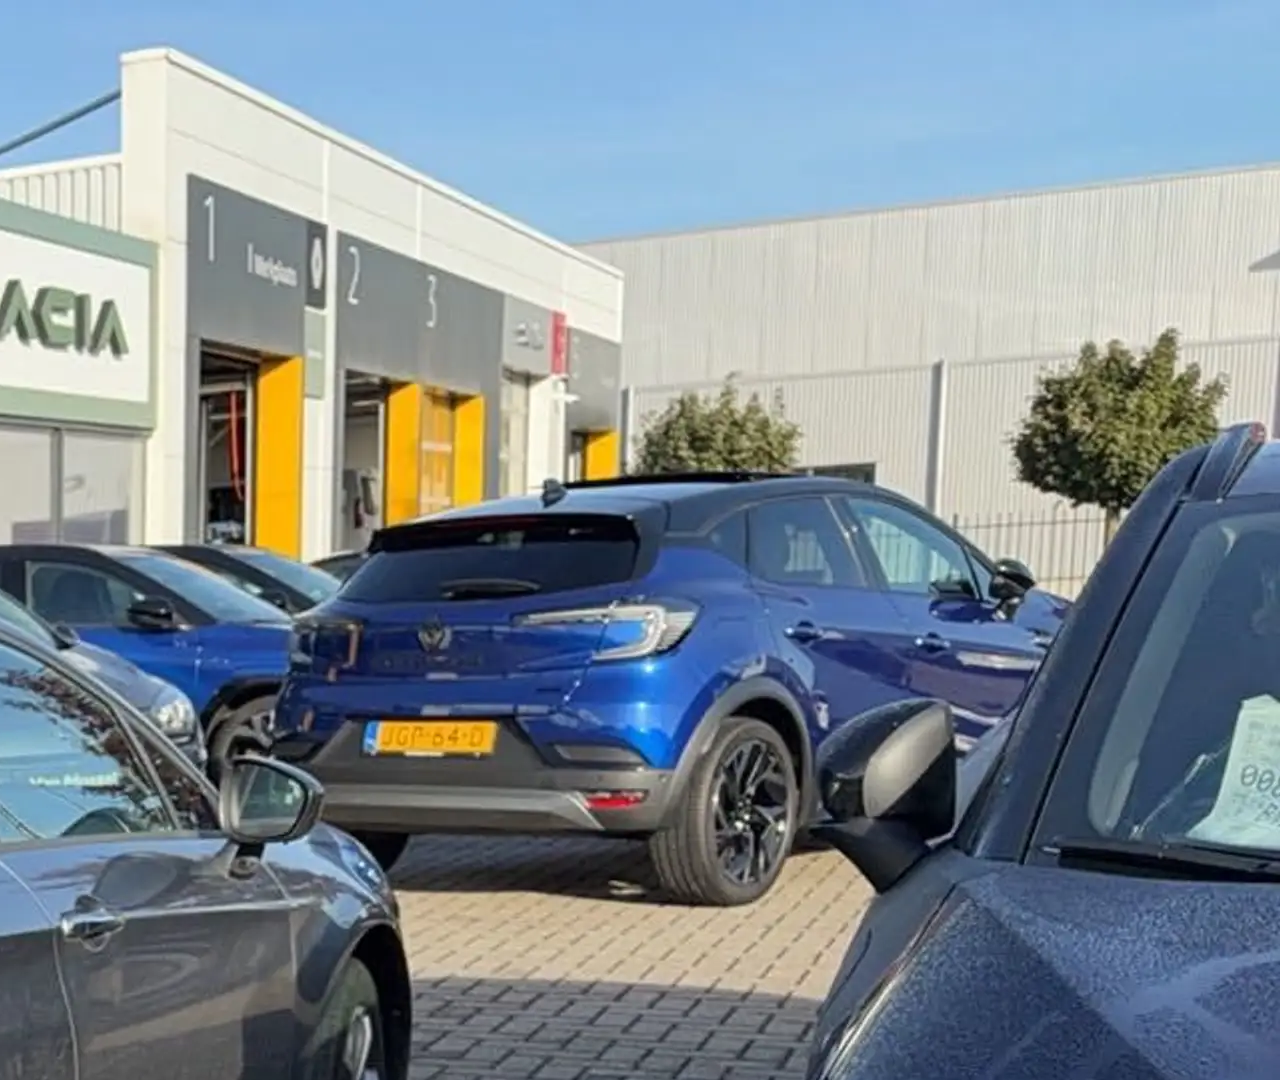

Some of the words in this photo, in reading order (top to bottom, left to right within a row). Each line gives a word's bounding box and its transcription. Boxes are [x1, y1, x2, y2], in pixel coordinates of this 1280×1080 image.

[204, 195, 216, 262] 1
[347, 245, 361, 305] 2
[426, 273, 438, 329] 3
